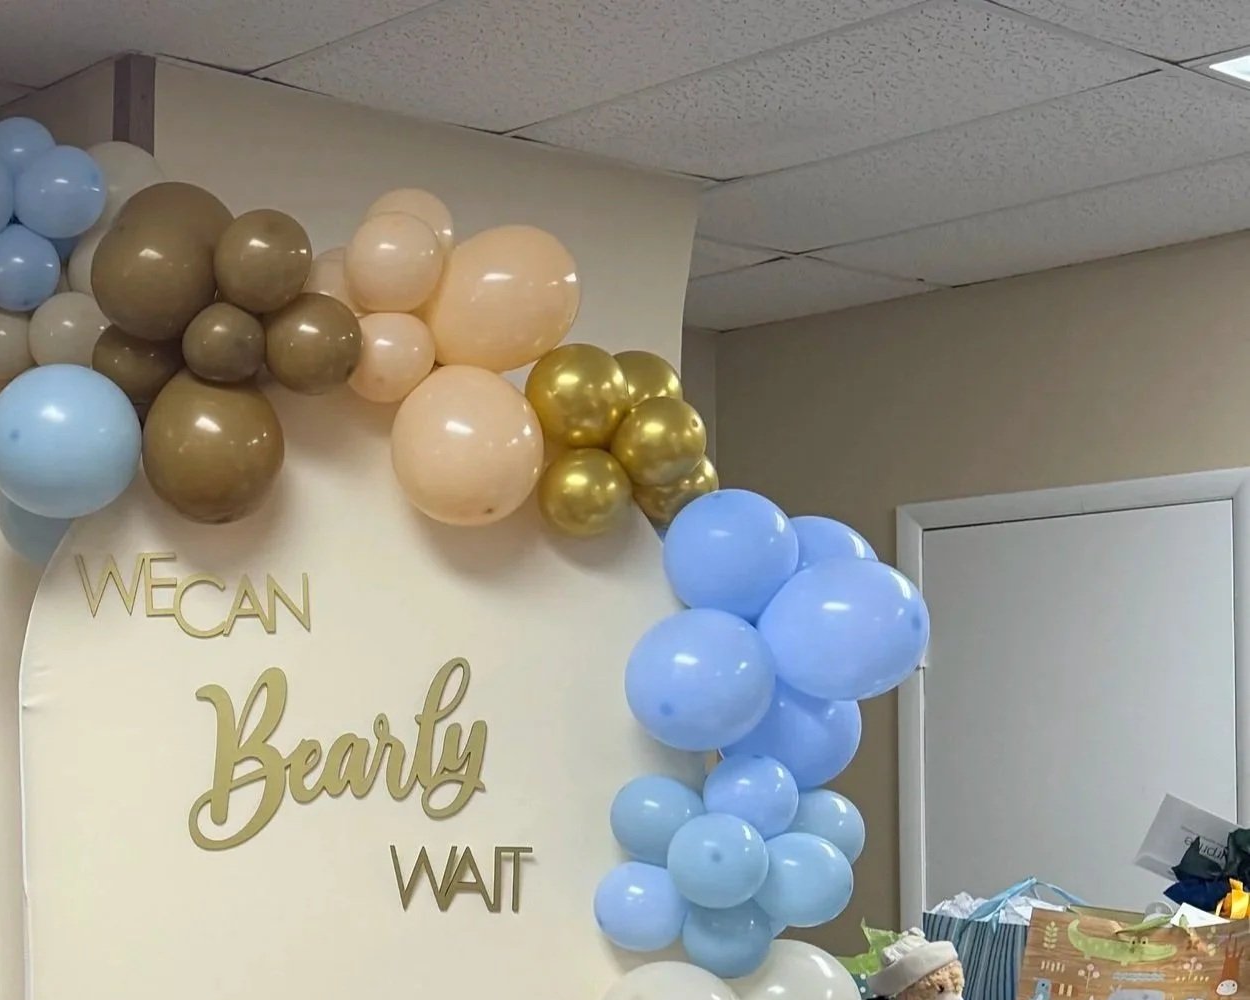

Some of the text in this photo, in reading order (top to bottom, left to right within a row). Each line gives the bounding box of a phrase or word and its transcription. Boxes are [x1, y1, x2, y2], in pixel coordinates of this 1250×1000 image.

[75, 552, 311, 638] WE CAN
[188, 657, 488, 851] Bearly
[390, 845, 533, 913] WAIT
